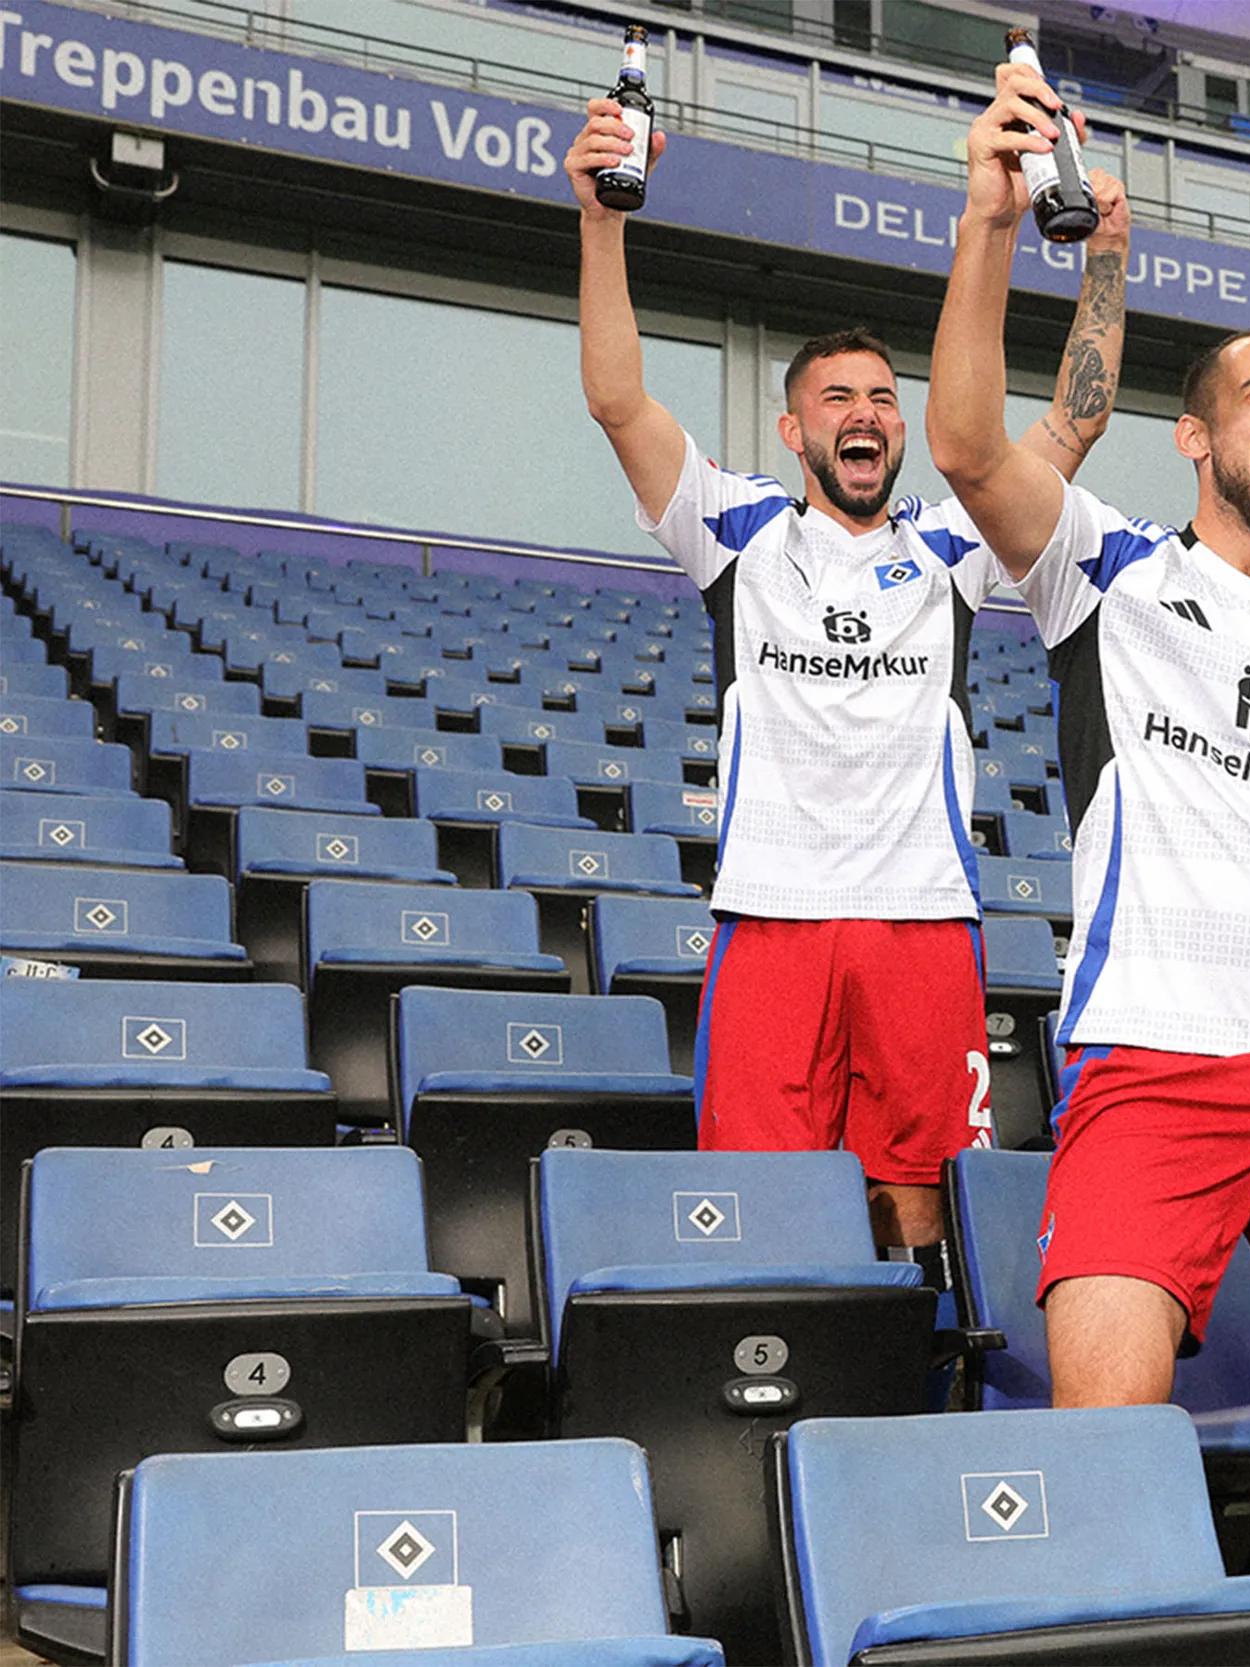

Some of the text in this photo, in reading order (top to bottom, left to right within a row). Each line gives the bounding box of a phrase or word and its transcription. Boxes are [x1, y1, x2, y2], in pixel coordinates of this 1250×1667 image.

[434, 100, 558, 178] Voß
[758, 641, 929, 681] HanseMrkur
[995, 1016, 1005, 1031] 7
[754, 1343, 768, 1366] 5
[248, 1362, 266, 1387] 4
